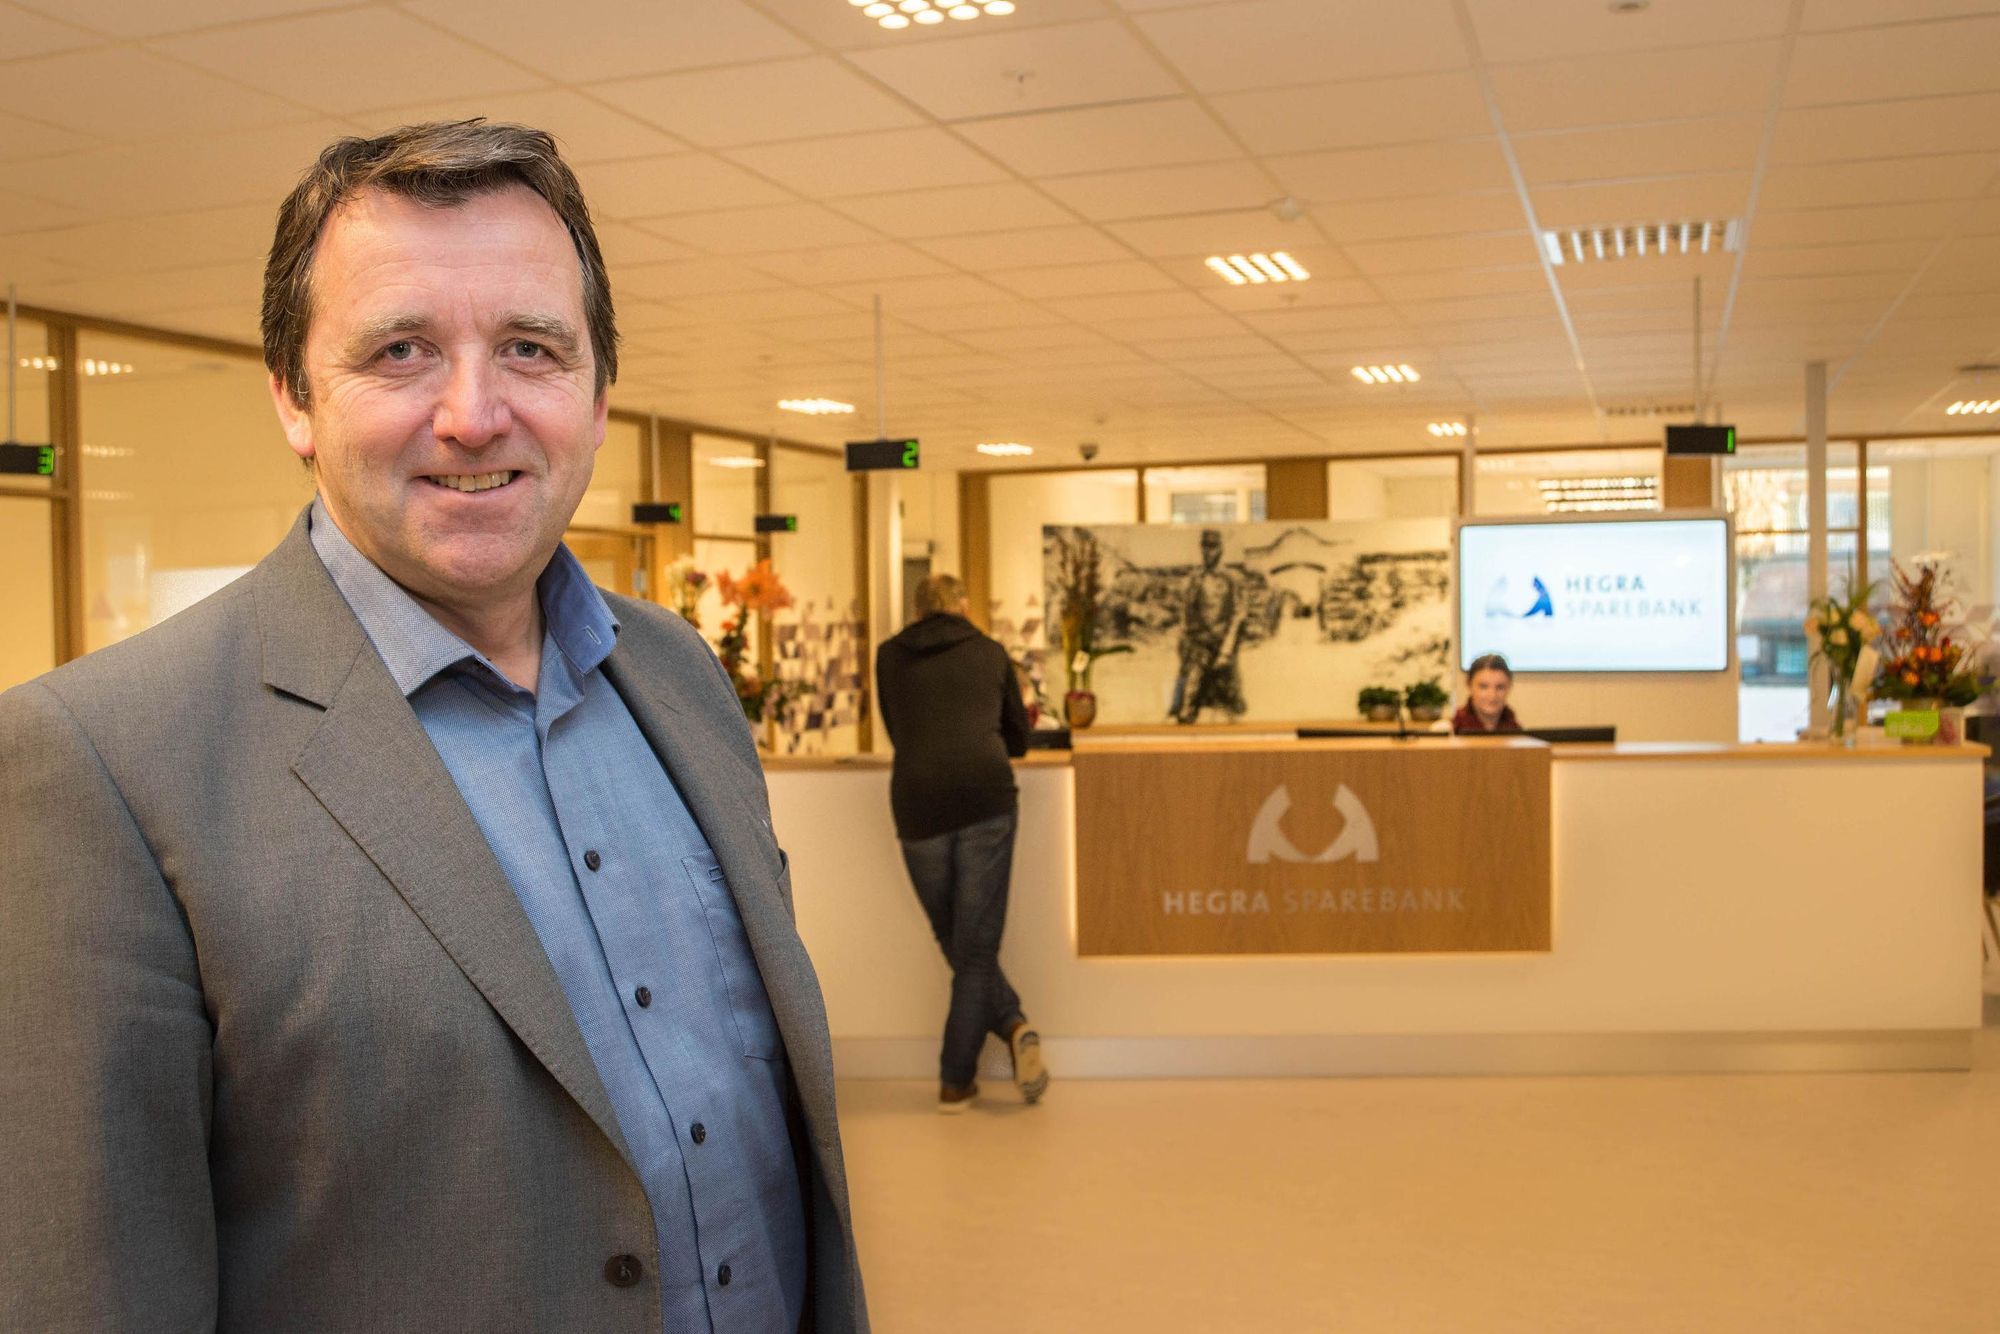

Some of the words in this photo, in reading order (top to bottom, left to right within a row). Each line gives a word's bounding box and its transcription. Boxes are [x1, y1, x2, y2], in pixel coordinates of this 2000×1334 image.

[1727, 428, 1734, 452] 1
[38, 446, 54, 474] 3
[903, 441, 918, 467] 2
[1566, 576, 1645, 591] HEGRA
[1567, 599, 1702, 618] SPAREBANK
[1162, 891, 1271, 915] HEGRA
[1283, 888, 1466, 913] SPAREBANK
